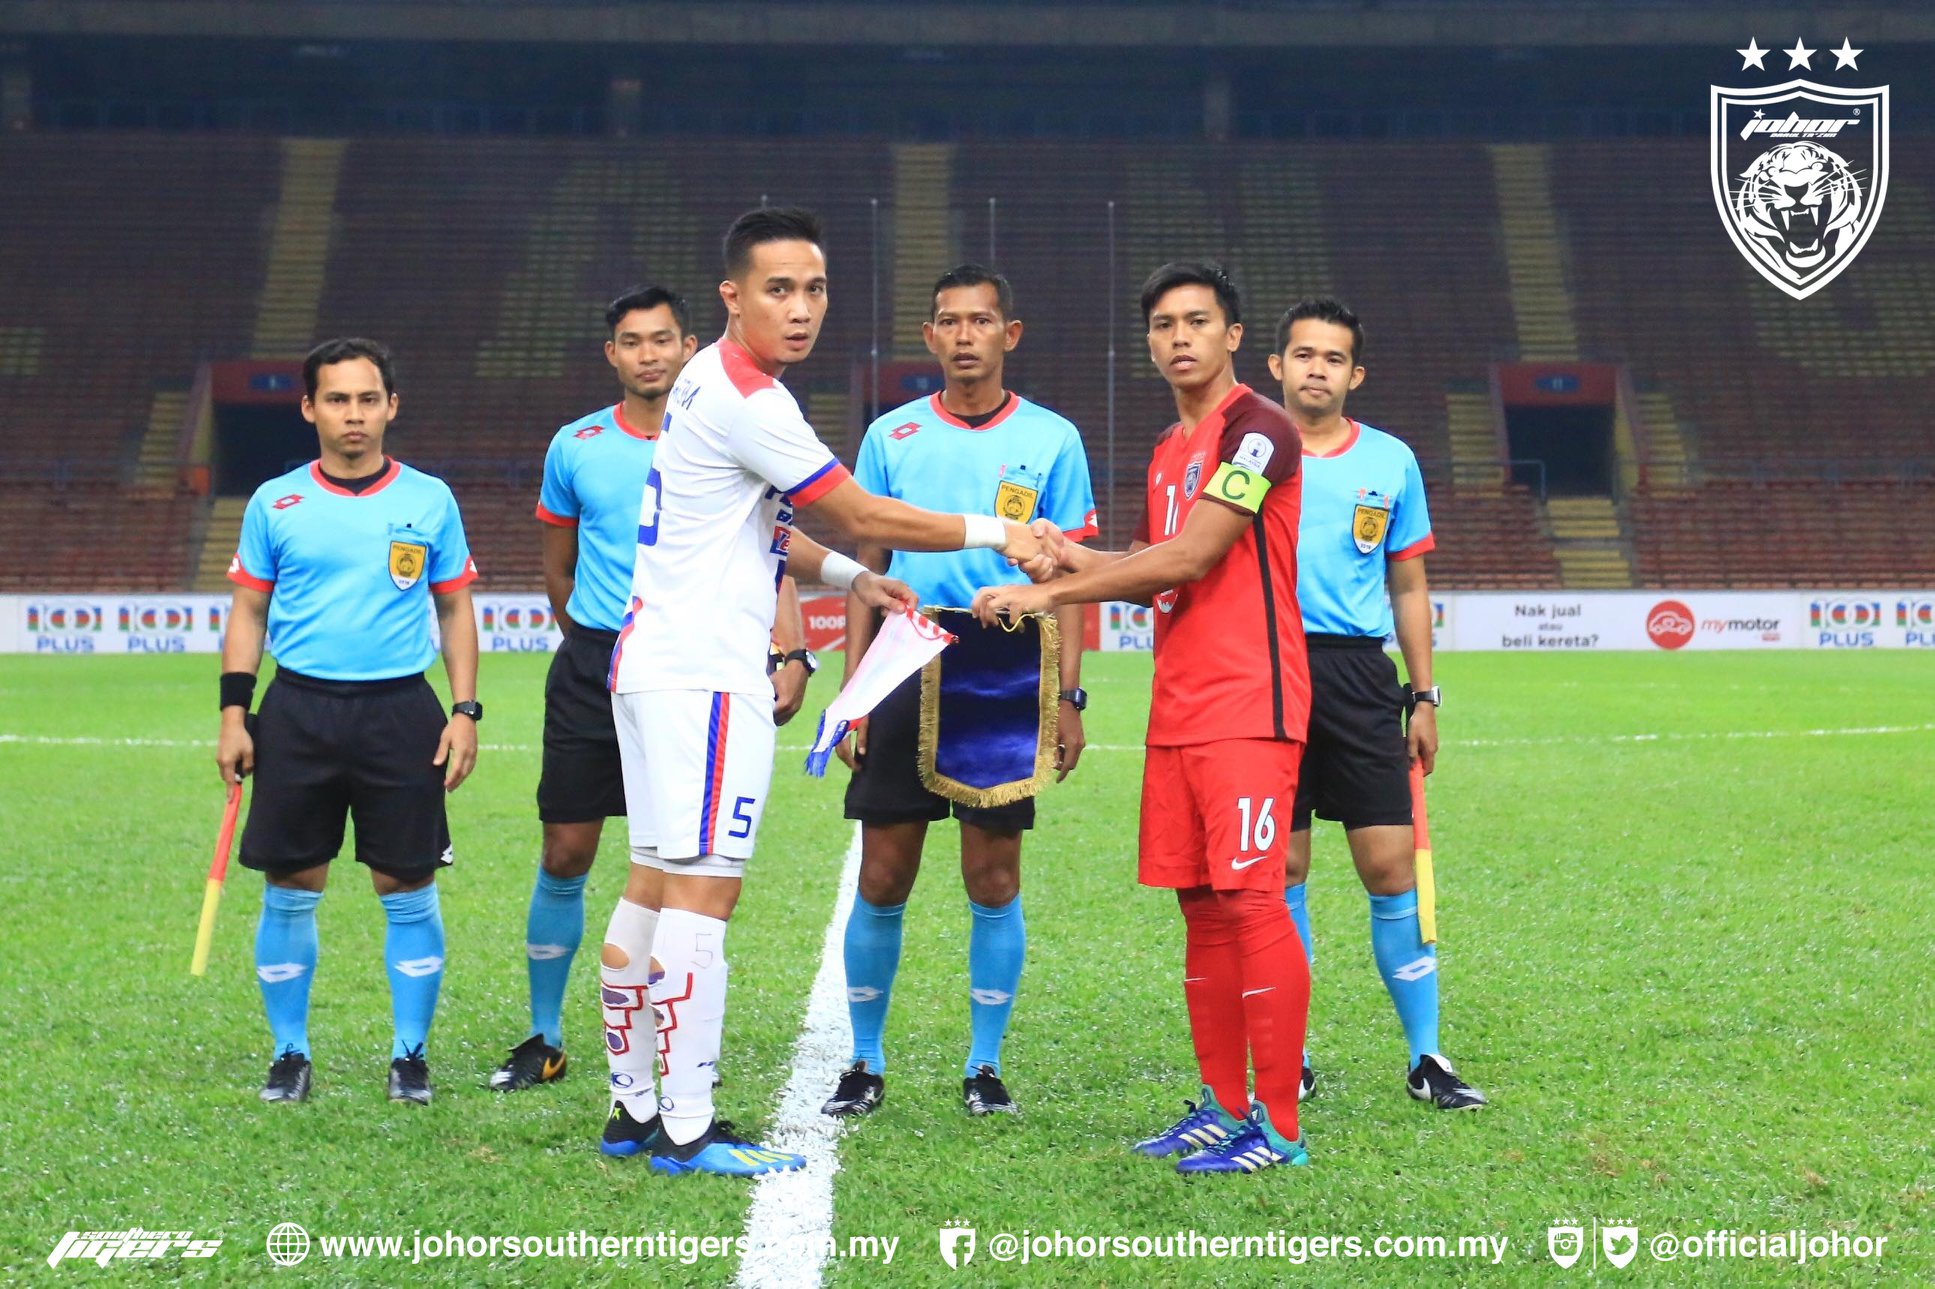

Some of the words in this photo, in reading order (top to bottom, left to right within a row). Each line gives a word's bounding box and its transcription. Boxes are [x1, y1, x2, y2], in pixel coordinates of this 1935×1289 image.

[1221, 470, 1250, 500] C
[1515, 604, 1546, 617] Nak
[1551, 604, 1582, 619] jual
[1701, 618, 1780, 634] mymotor
[37, 636, 94, 651] PLUS
[128, 636, 185, 651] PLUS
[492, 636, 549, 651] PLUS
[1502, 634, 1533, 648] beli
[1538, 634, 1600, 648] kereta?
[1819, 632, 1875, 647] PLUS
[728, 796, 756, 839] 5
[1237, 797, 1276, 852] 16
